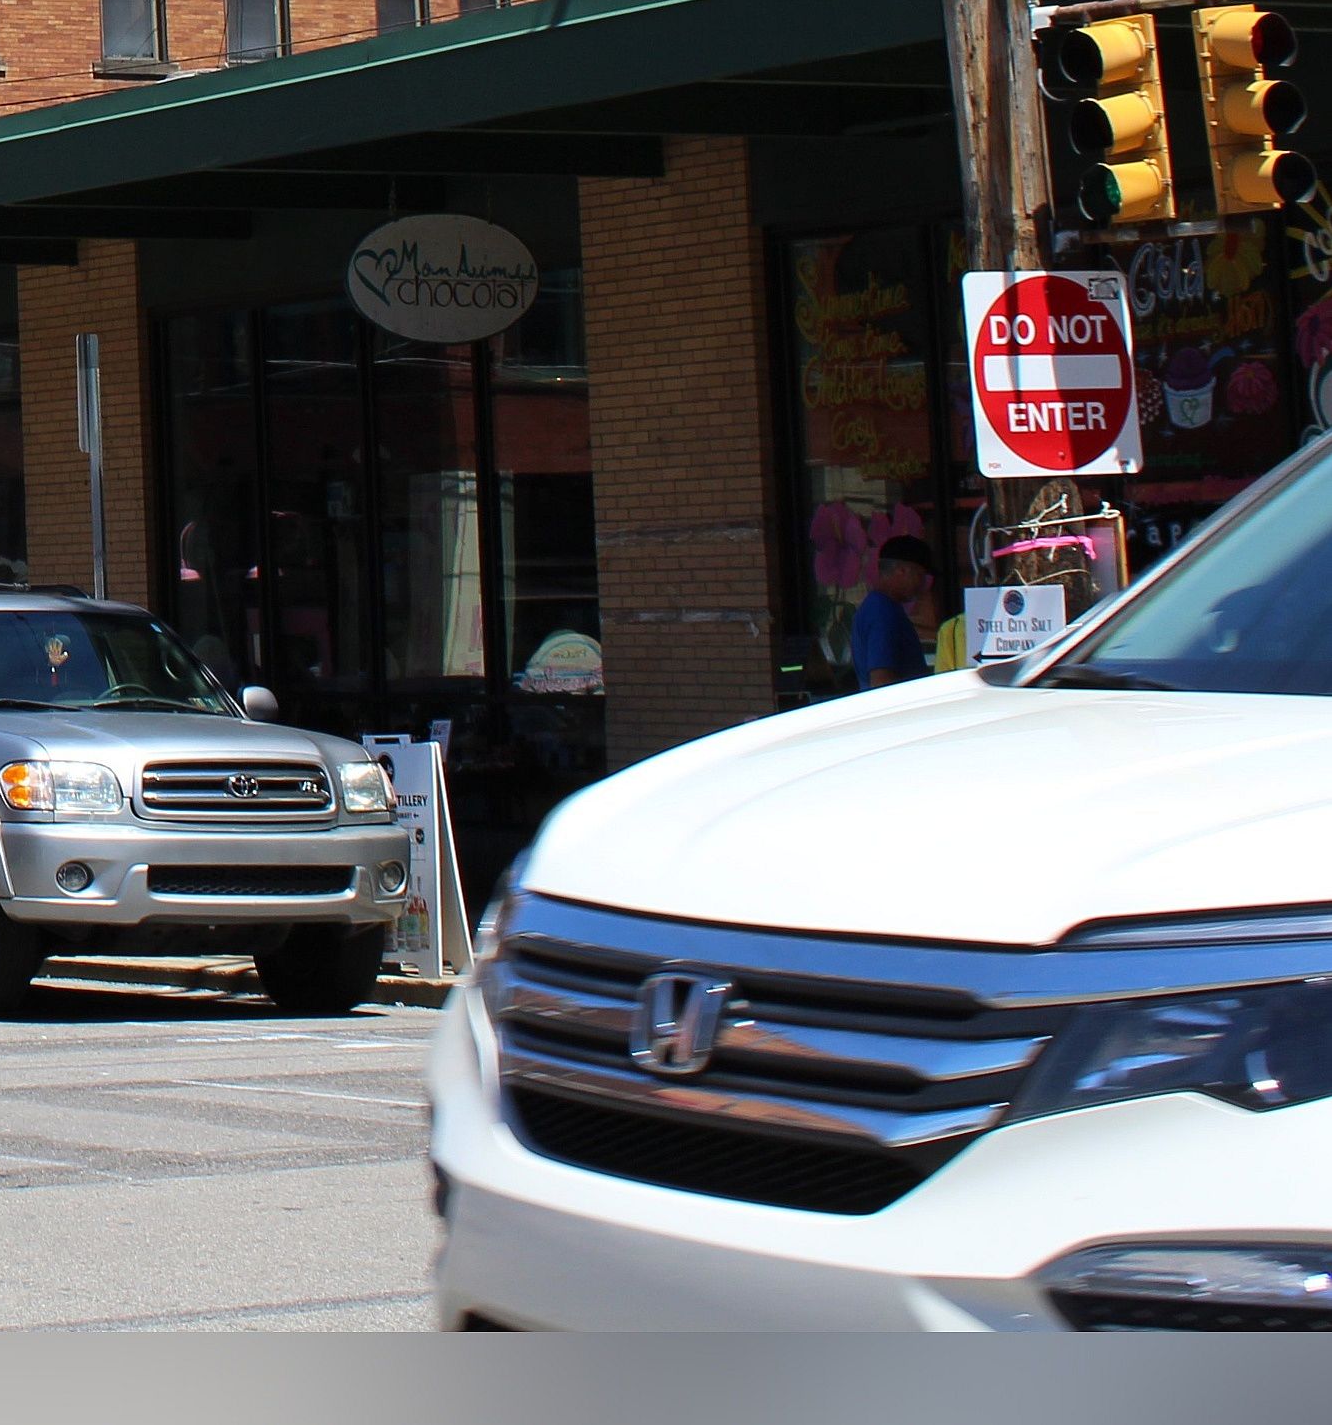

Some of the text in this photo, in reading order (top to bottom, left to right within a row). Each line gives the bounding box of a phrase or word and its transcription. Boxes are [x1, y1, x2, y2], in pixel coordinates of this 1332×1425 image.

[398, 239, 452, 277] Mon
[397, 275, 526, 309] chocolat
[988, 314, 1036, 346] DO
[1047, 314, 1108, 344] NOT
[1006, 401, 1108, 433] ENTER
[396, 794, 429, 807] TILLERY
